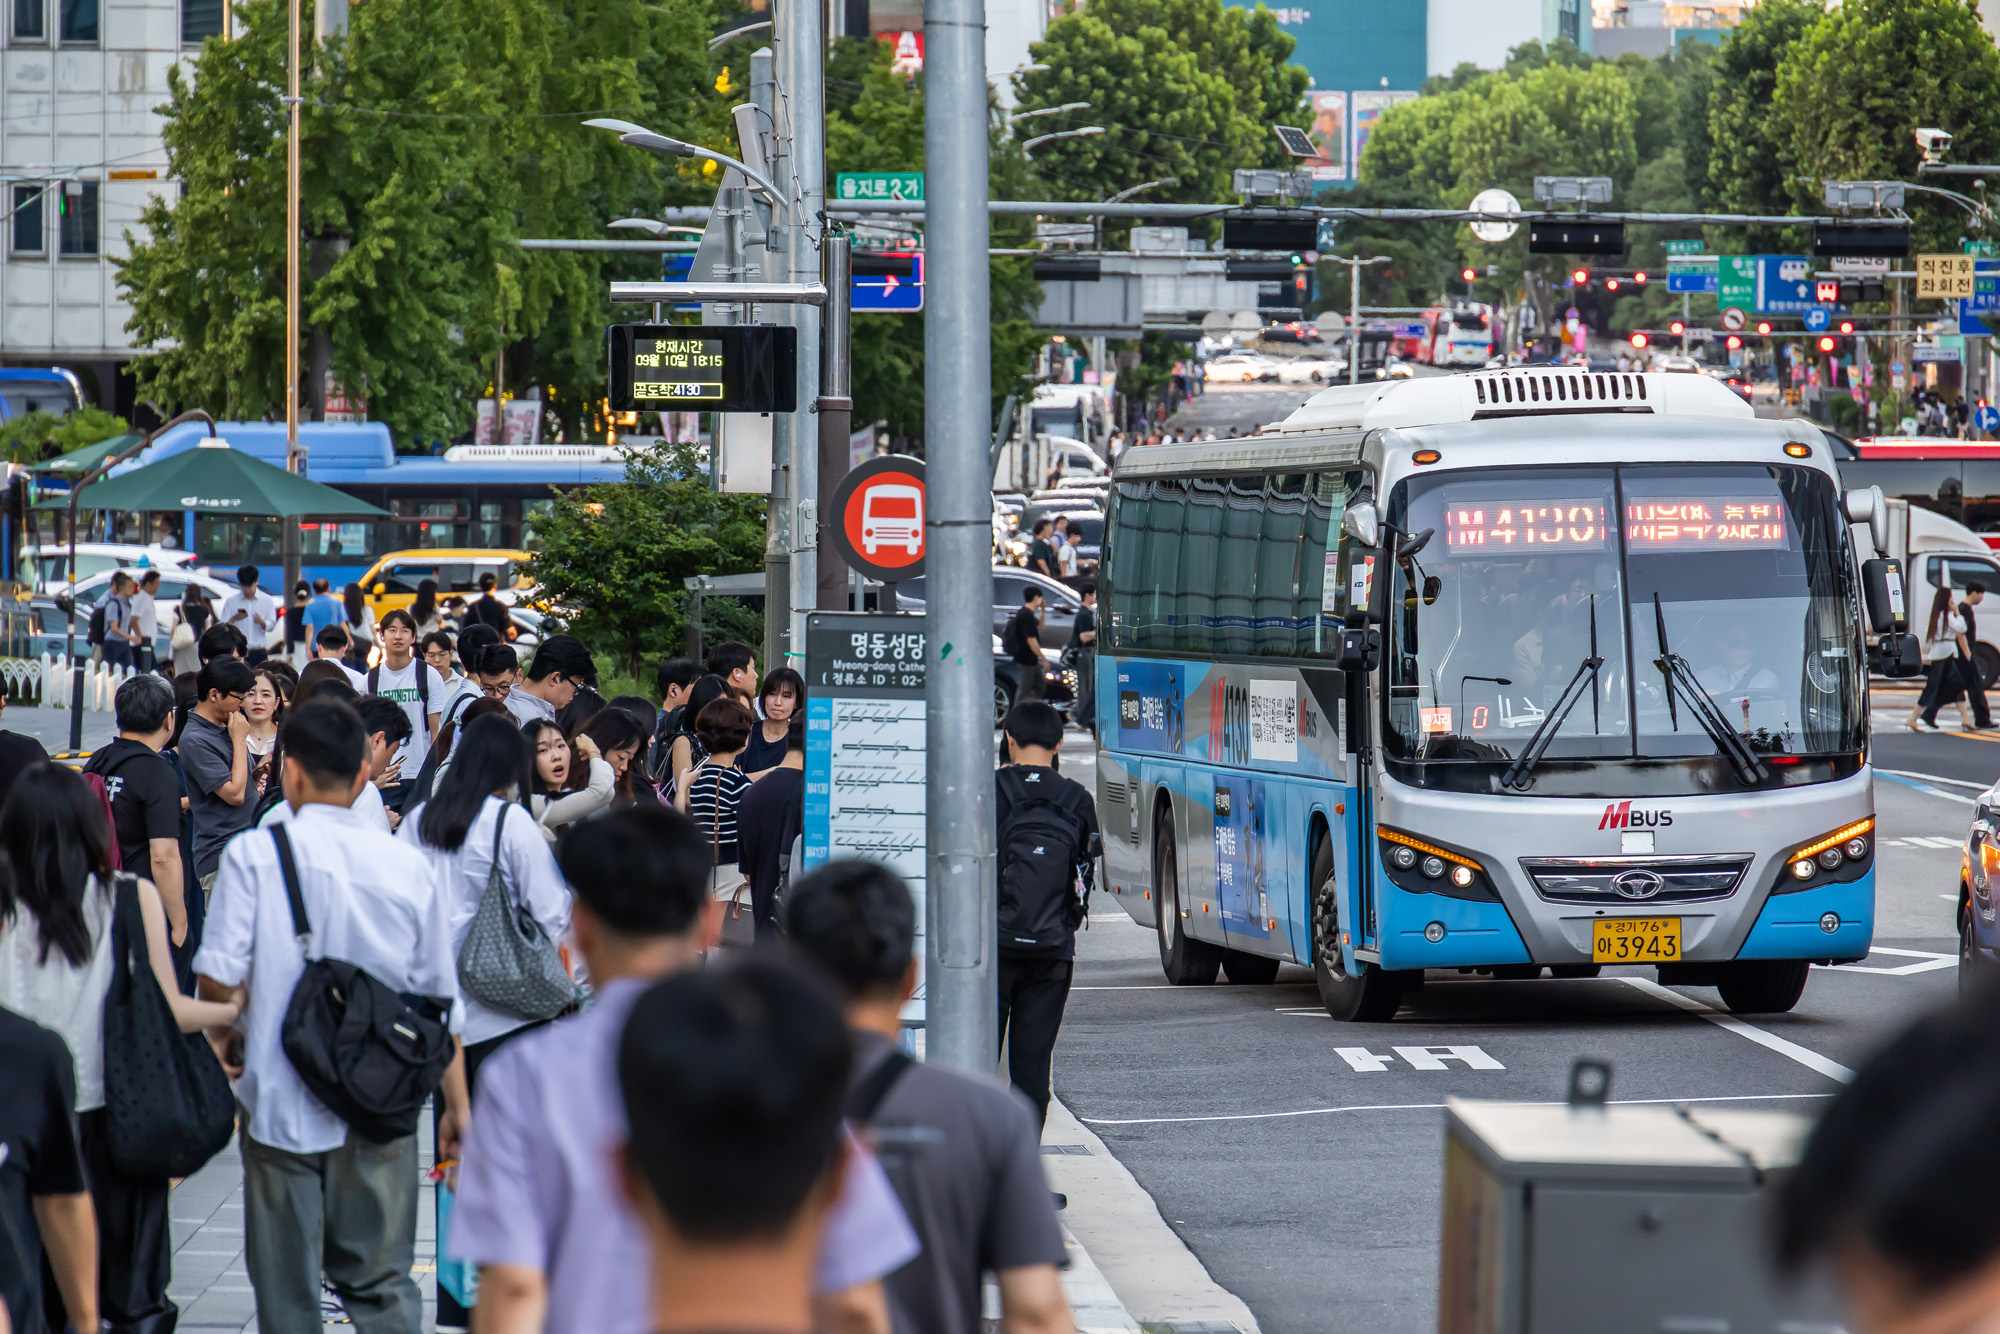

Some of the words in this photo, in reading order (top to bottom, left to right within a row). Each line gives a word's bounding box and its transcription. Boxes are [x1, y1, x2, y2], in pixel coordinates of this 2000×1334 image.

[1922, 278, 1971, 292] 좌회전
[655, 340, 703, 353] 현재시간
[635, 355, 660, 367] 09월
[665, 355, 688, 367] 10일
[693, 355, 722, 366] 18:15
[851, 632, 926, 660] 명동성당
[832, 660, 896, 673] Myeong-dong
[832, 673, 868, 686] 정류소
[872, 675, 886, 685] ID
[1299, 698, 1317, 738] MBUS
[1422, 713, 1450, 726] 빈자리
[1472, 706, 1489, 729] 0
[1598, 800, 1673, 831] MBUS
[1615, 922, 1637, 933] 경기
[1640, 921, 1660, 933] 76
